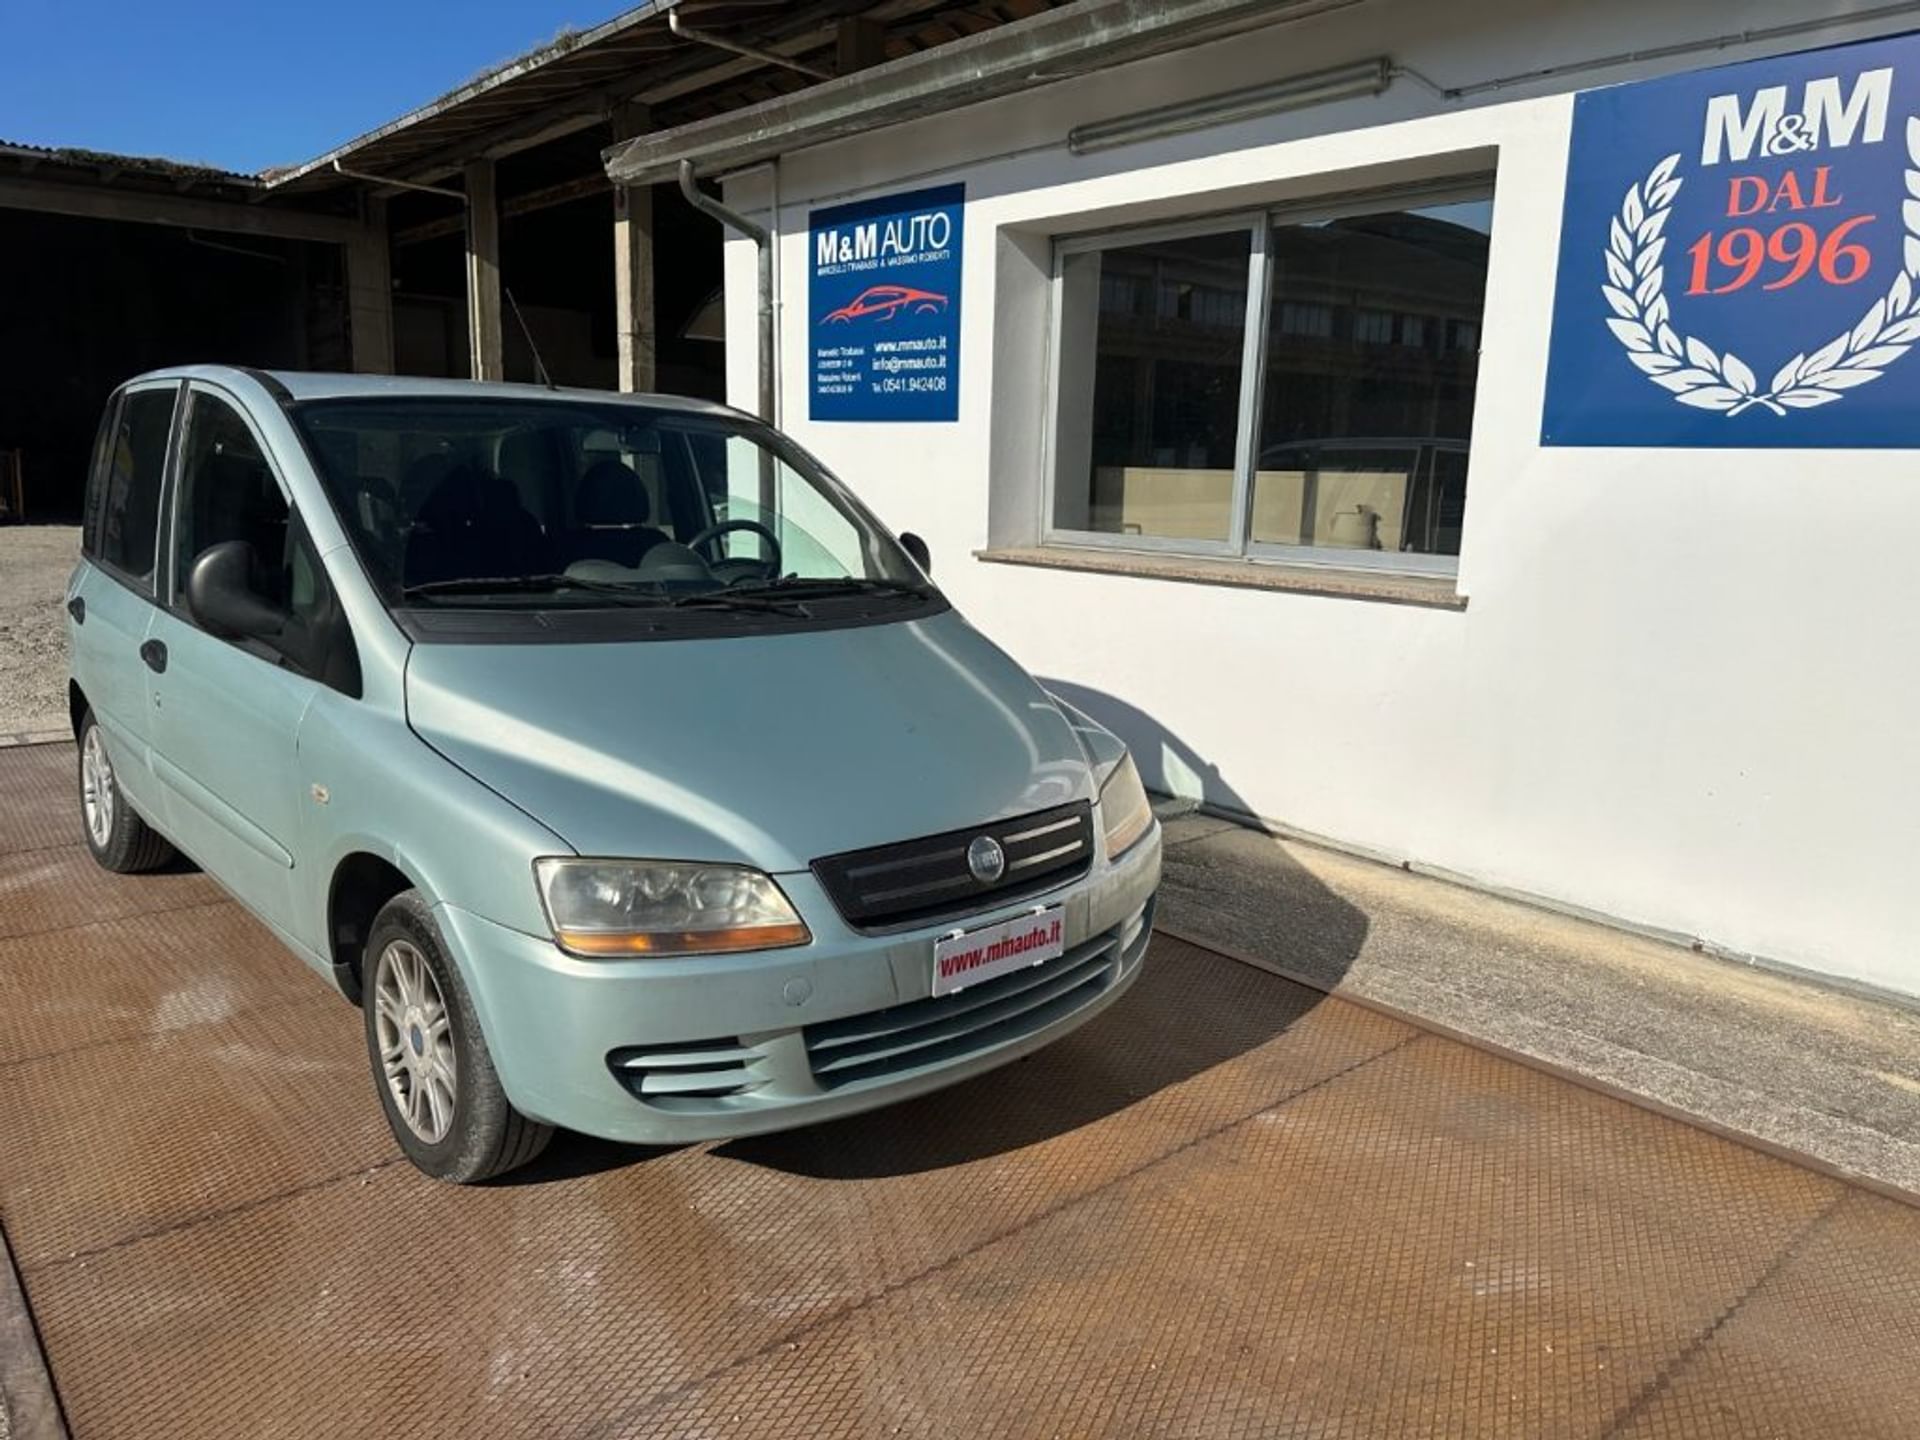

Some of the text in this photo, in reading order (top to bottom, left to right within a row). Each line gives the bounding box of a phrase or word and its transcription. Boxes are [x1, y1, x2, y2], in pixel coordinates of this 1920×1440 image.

[1701, 67, 1893, 166] M&M
[1726, 166, 1843, 217] DAL
[817, 212, 950, 266] M&M AUTO
[1684, 215, 1875, 296] 1996
[872, 355, 946, 374] info@mmauto.it
[874, 335, 947, 352] www.mmauto.it
[883, 376, 946, 393] 0541.942408
[940, 919, 1061, 978] www.mmauto.it
